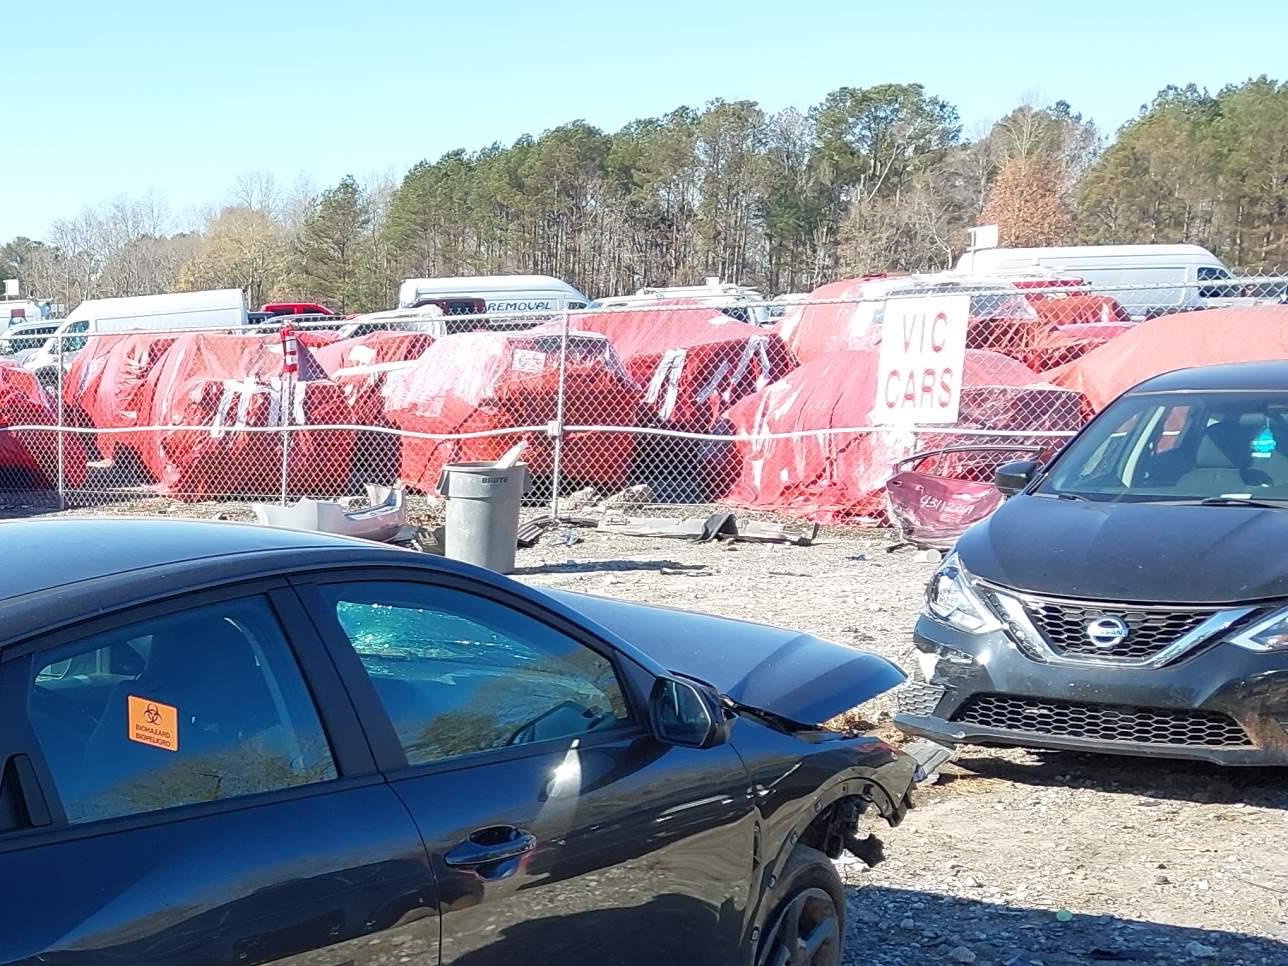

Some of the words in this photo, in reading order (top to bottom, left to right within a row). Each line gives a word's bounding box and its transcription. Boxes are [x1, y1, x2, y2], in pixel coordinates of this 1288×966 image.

[487, 301, 553, 311] REMOVAL
[902, 312, 948, 353] VIC
[884, 367, 954, 409] CARS
[135, 723, 171, 739] BIOHAZARD
[135, 732, 171, 747] BIOPELIGRO
